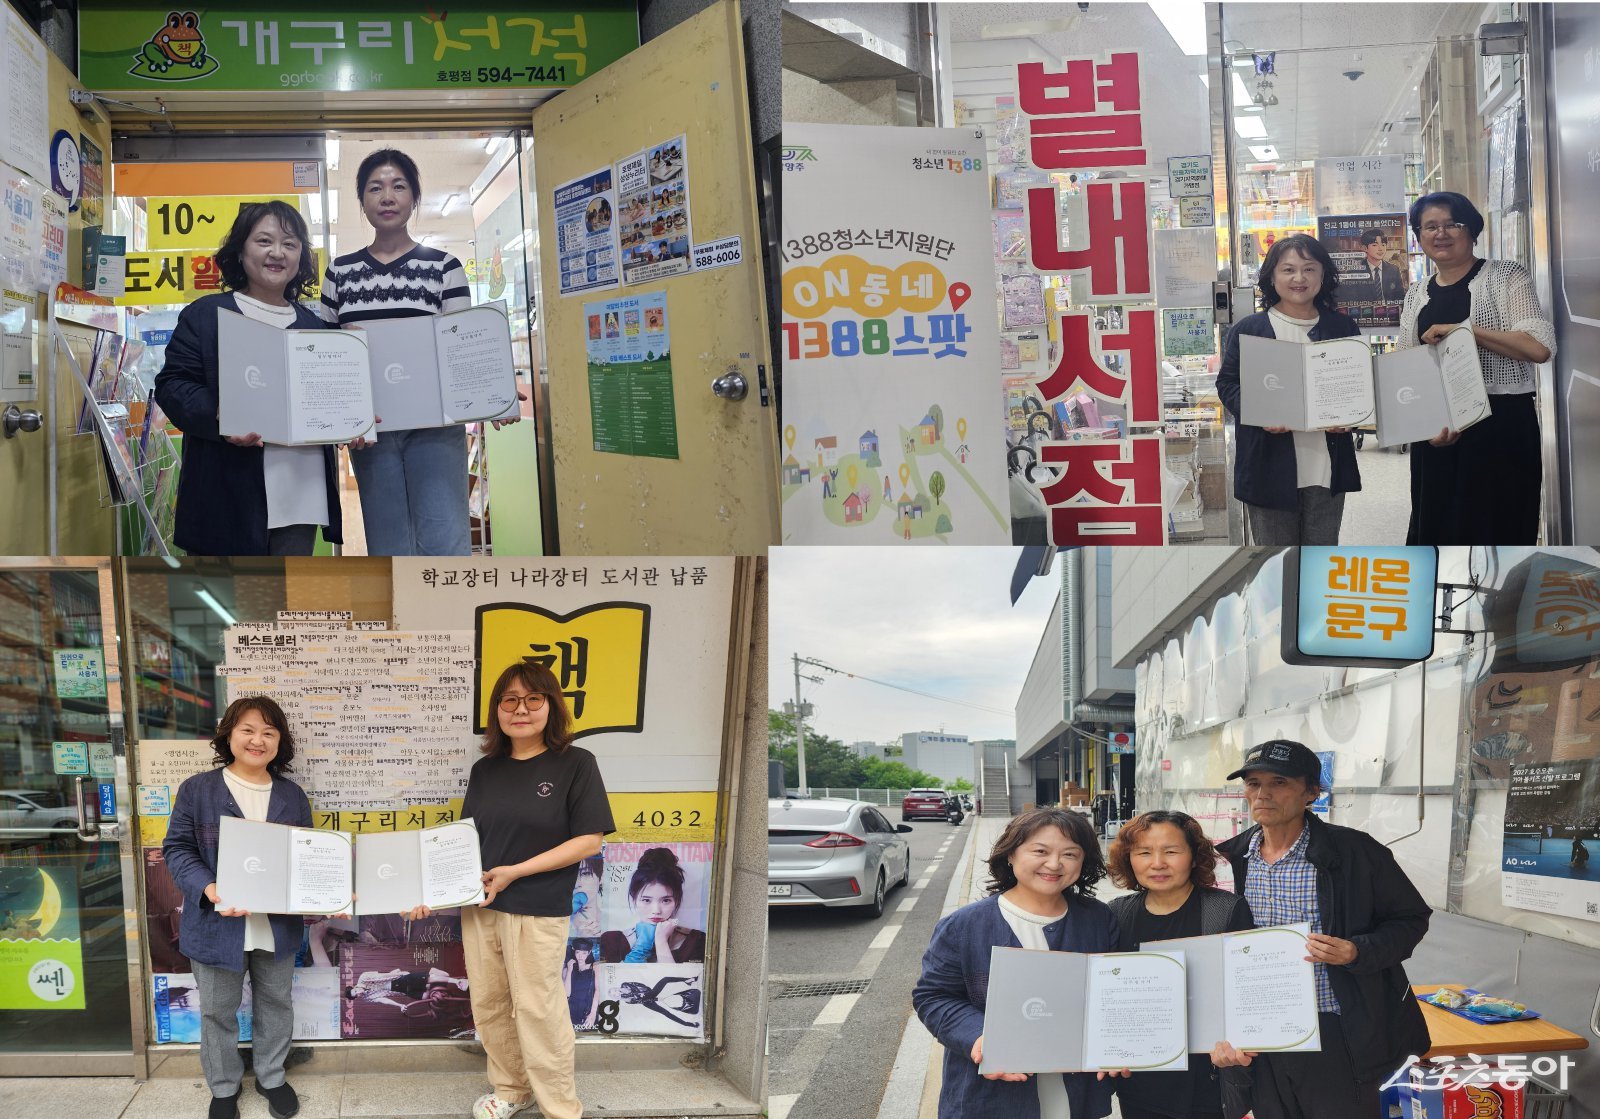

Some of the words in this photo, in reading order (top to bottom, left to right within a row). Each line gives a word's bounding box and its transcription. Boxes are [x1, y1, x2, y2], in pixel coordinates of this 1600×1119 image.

[177, 42, 192, 55] 책
[437, 70, 472, 82] 호평점
[477, 66, 566, 82] 594-7441
[782, 162, 805, 172] 양주
[912, 157, 944, 170] 청소년
[947, 158, 983, 174] 1388
[1336, 160, 1356, 172] 영업
[1361, 158, 1382, 171] 시간
[695, 249, 741, 268] 588-6006
[1017, 52, 1164, 546] 별내서점
[782, 313, 972, 361] 1388스팟
[421, 567, 499, 588] 학교장터
[511, 567, 588, 588] 나라장터
[600, 567, 660, 587] 도서관
[670, 566, 708, 586] 납품
[1328, 555, 1411, 595] 레몬
[1325, 602, 1408, 641] 문구
[238, 634, 297, 646] 베스트셀러
[522, 636, 589, 720] 책
[1529, 767, 1554, 775] 호주오픈
[1554, 772, 1581, 781] 프로그램
[102, 785, 113, 815] 당기세요
[632, 810, 702, 828] 4032
[36, 967, 65, 996] 쎈
